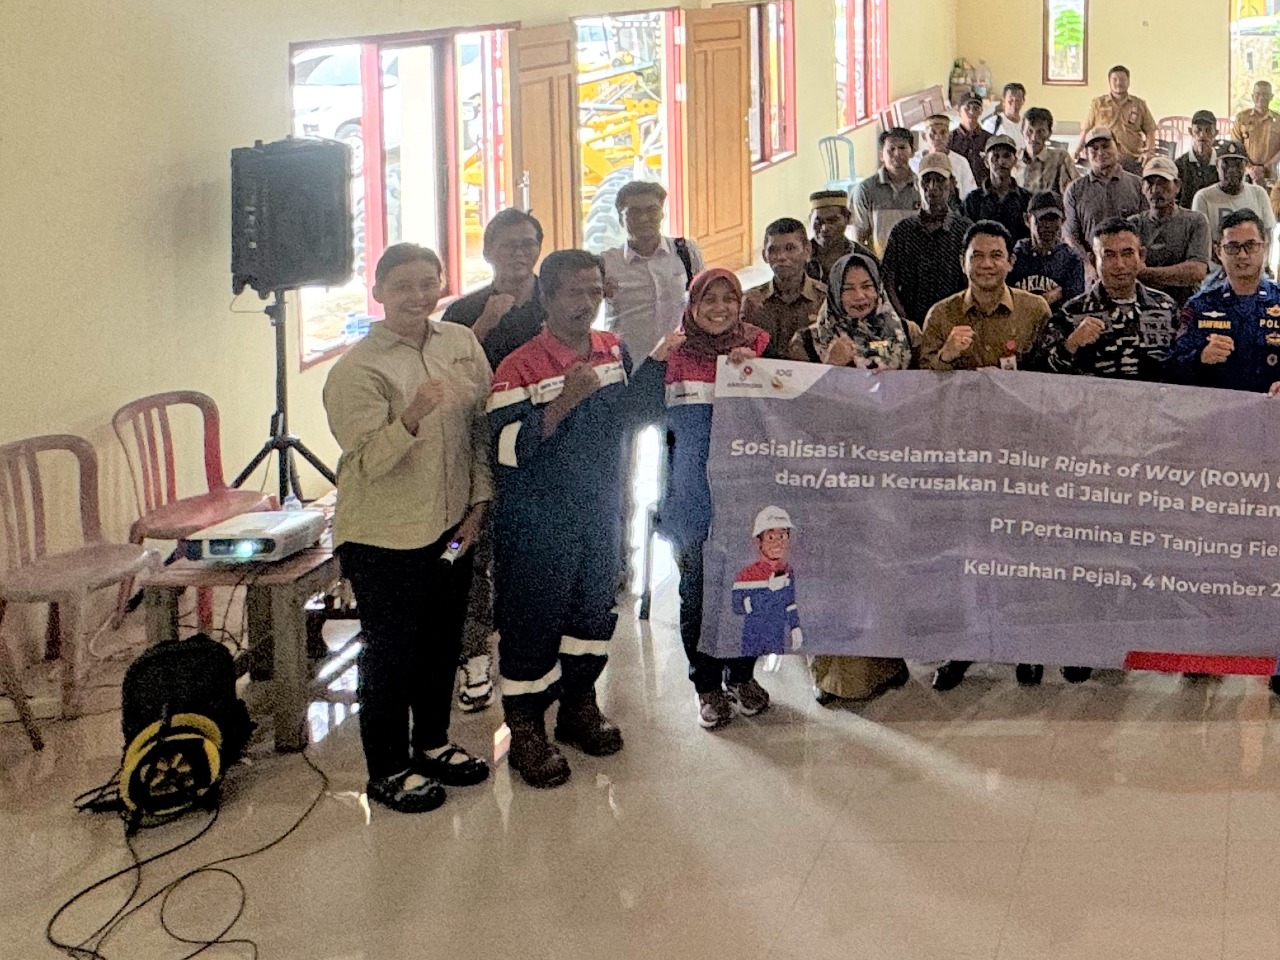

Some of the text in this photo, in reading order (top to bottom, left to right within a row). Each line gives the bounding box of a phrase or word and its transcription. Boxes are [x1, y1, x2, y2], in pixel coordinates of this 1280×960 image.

[730, 438, 845, 458] Sosialisasi
[851, 444, 993, 464] Keselamatan
[997, 448, 1050, 469] Jalur
[1054, 455, 1111, 477] Right
[1116, 462, 1141, 479] of
[1145, 464, 1196, 487] Way
[1200, 467, 1271, 493] (ROW)
[774, 467, 875, 489] dan/atau
[881, 473, 997, 492] Kerusakan
[1002, 477, 1050, 497] Laut
[1054, 482, 1075, 500] di
[1079, 485, 1133, 505] Jalur
[1138, 489, 1185, 512] Pipa
[990, 517, 1017, 534] PT
[1021, 520, 1124, 544] Pertamina
[1129, 529, 1156, 547] EP
[1160, 533, 1243, 559] Tanjung
[963, 558, 1067, 581] Kelurahan
[1072, 566, 1137, 590] Pejala,
[1141, 573, 1158, 589] 4
[1160, 575, 1266, 597] November
